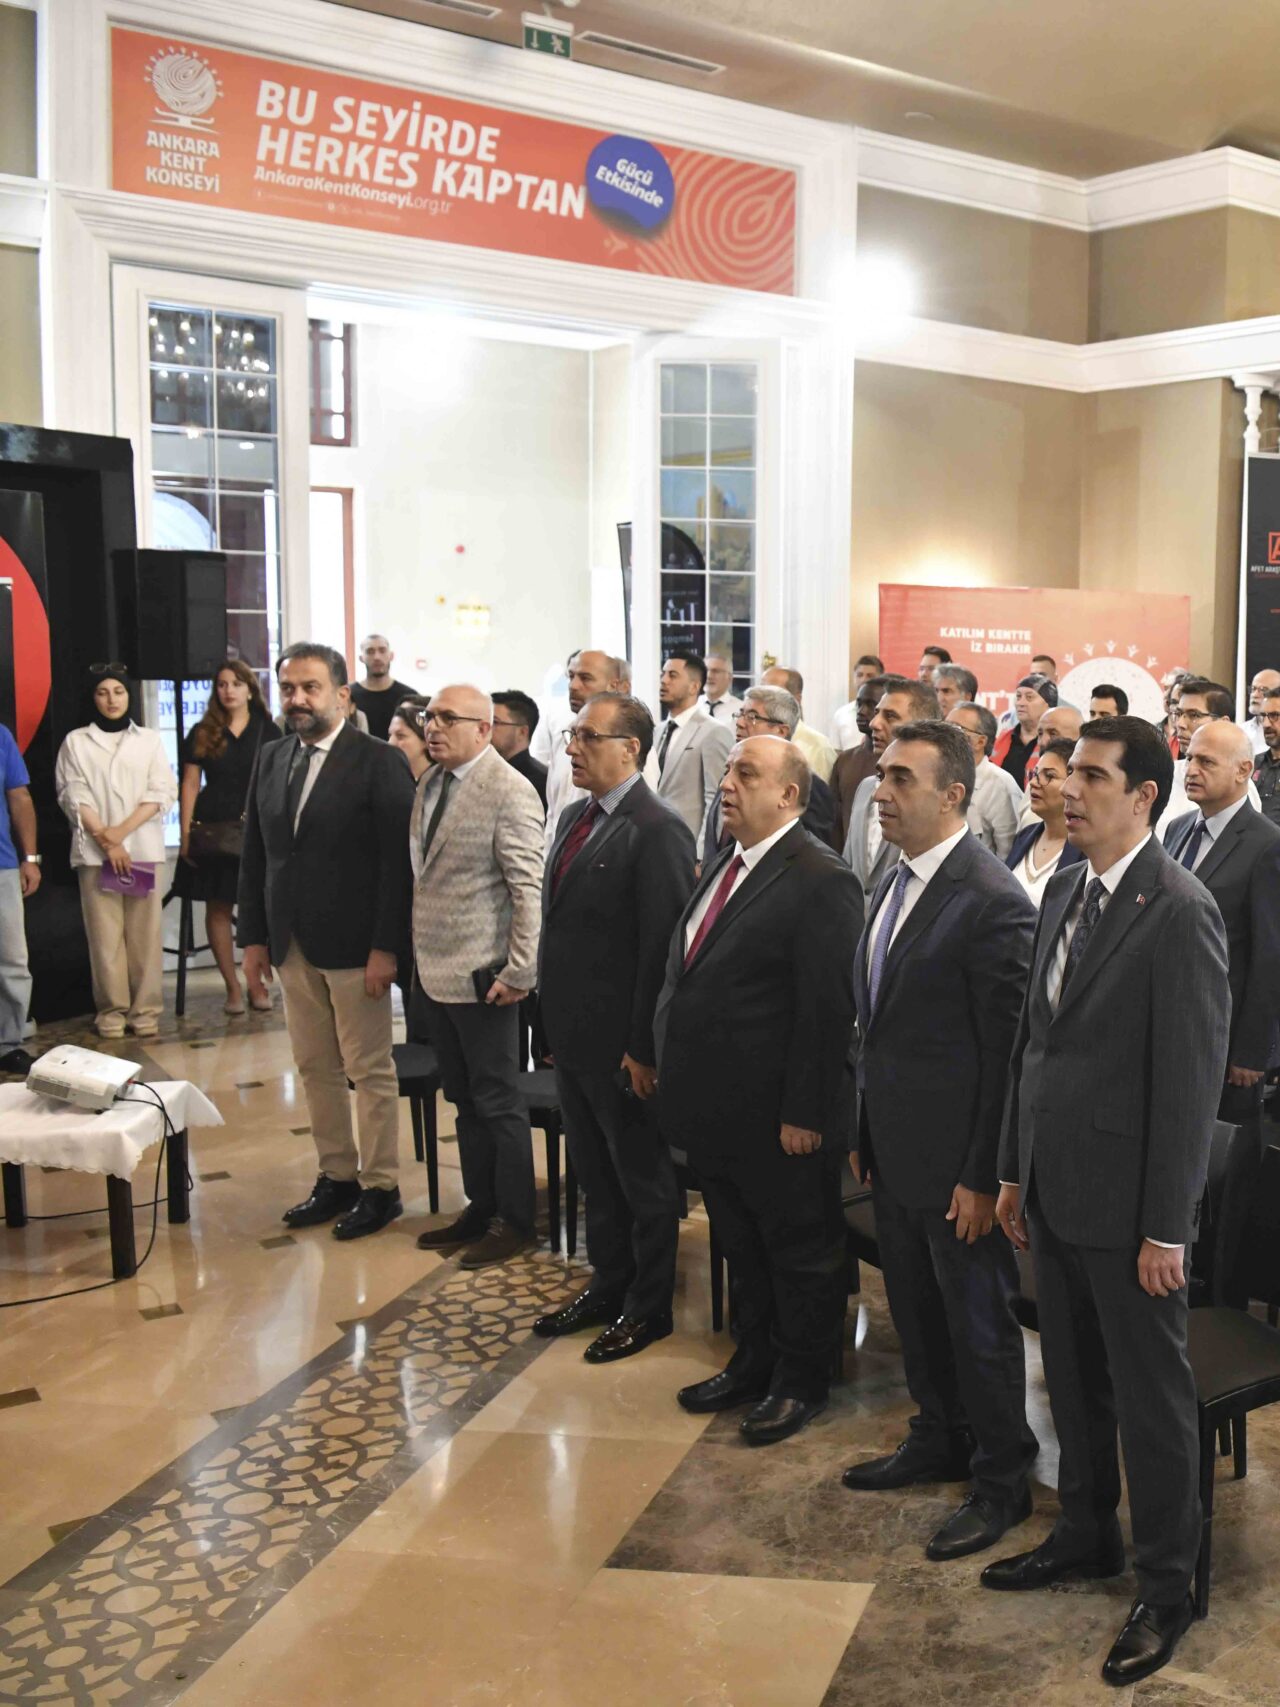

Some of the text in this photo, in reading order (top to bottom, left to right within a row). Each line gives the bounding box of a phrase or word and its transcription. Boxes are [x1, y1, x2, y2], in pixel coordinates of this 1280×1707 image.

[256, 79, 501, 163] BU SEYİRDE
[146, 130, 220, 159] ANKARA
[160, 150, 207, 173] KENT
[256, 125, 588, 220] HERKES KAPTAN
[616, 158, 654, 187] Gücü
[145, 166, 220, 194] KONSEYİ
[254, 165, 453, 216] AnkaraKentKonseyi.org.tr
[595, 165, 664, 208] Etkisinde
[940, 627, 985, 640] KATILIM
